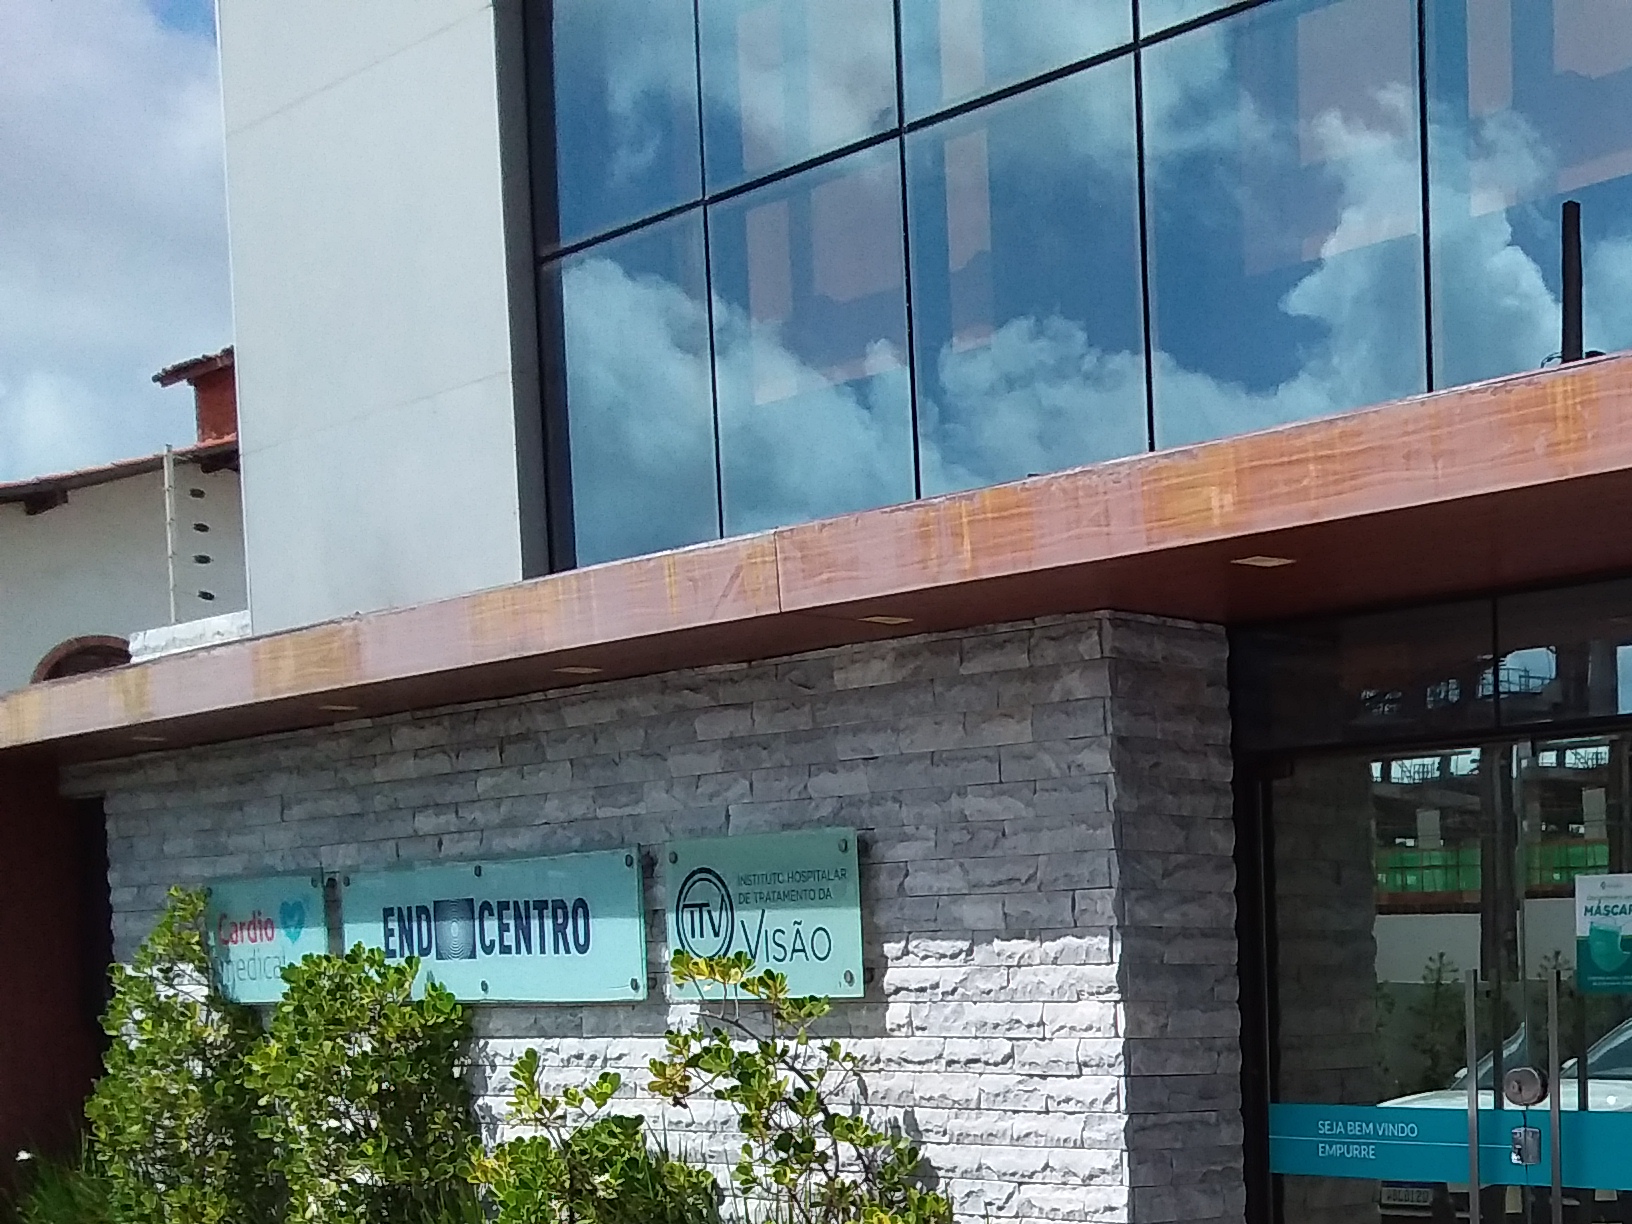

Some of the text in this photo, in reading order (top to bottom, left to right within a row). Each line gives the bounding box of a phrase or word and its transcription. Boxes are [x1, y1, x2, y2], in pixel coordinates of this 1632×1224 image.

[738, 868, 847, 887] INSTITUTO HOSPITALAR
[738, 887, 832, 904] DE TRATAMENTO DA
[217, 909, 276, 946] Cardio
[1317, 1120, 1418, 1138] SEJA BEM VINDO
[1317, 1143, 1376, 1159] EMPURRE
